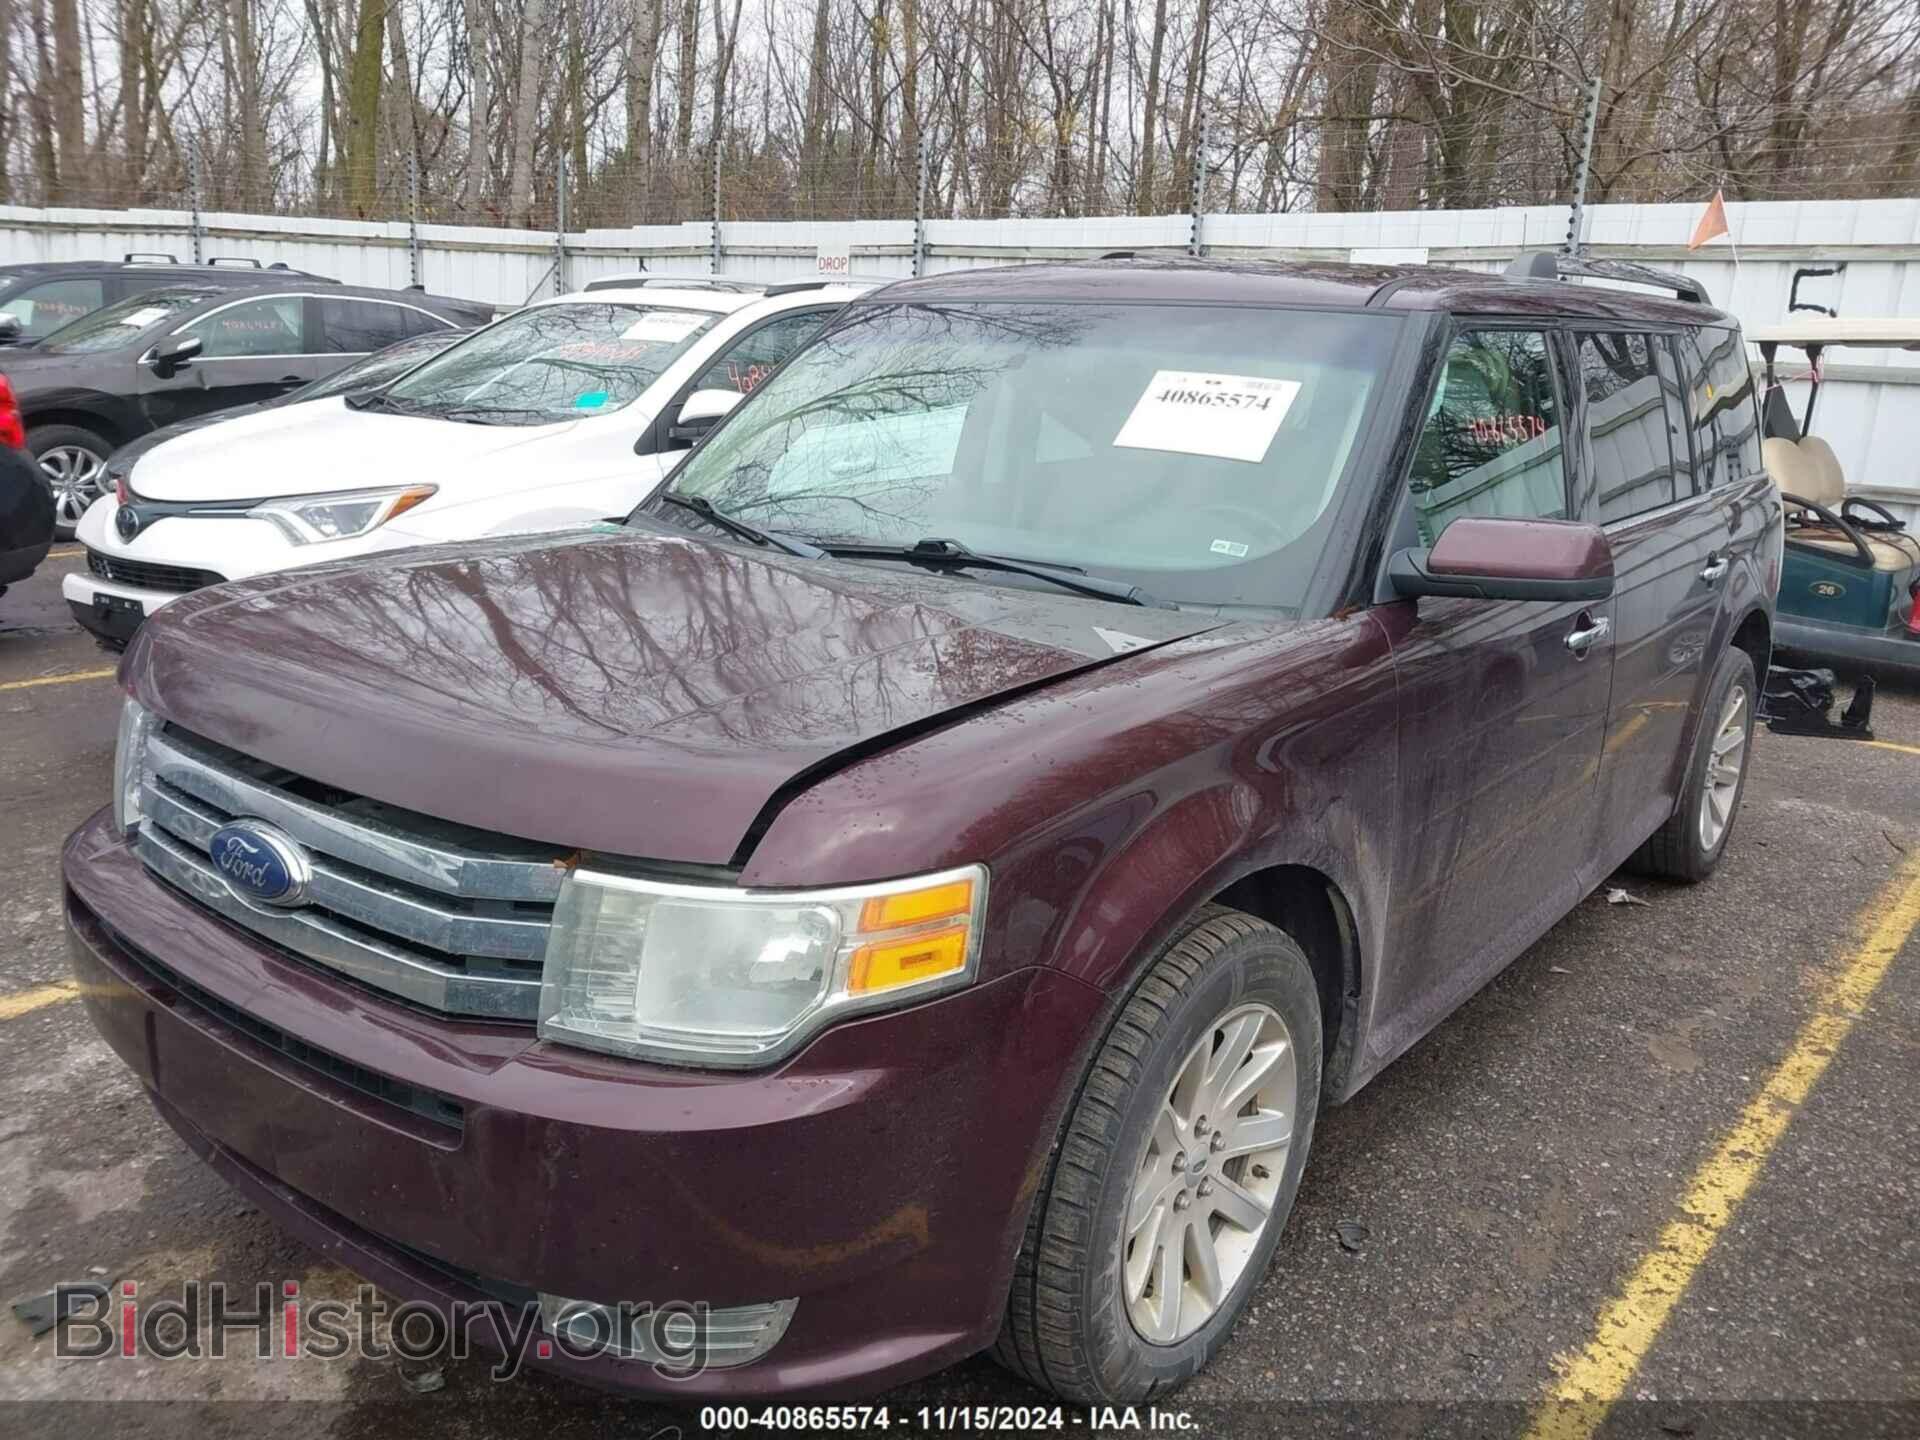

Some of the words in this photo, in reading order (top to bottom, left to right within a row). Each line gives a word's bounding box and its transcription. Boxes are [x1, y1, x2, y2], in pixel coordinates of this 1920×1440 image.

[818, 256, 848, 271] DROP
[1155, 388, 1273, 411] 40865574
[1818, 584, 1836, 596] 26
[220, 836, 271, 888] Ford
